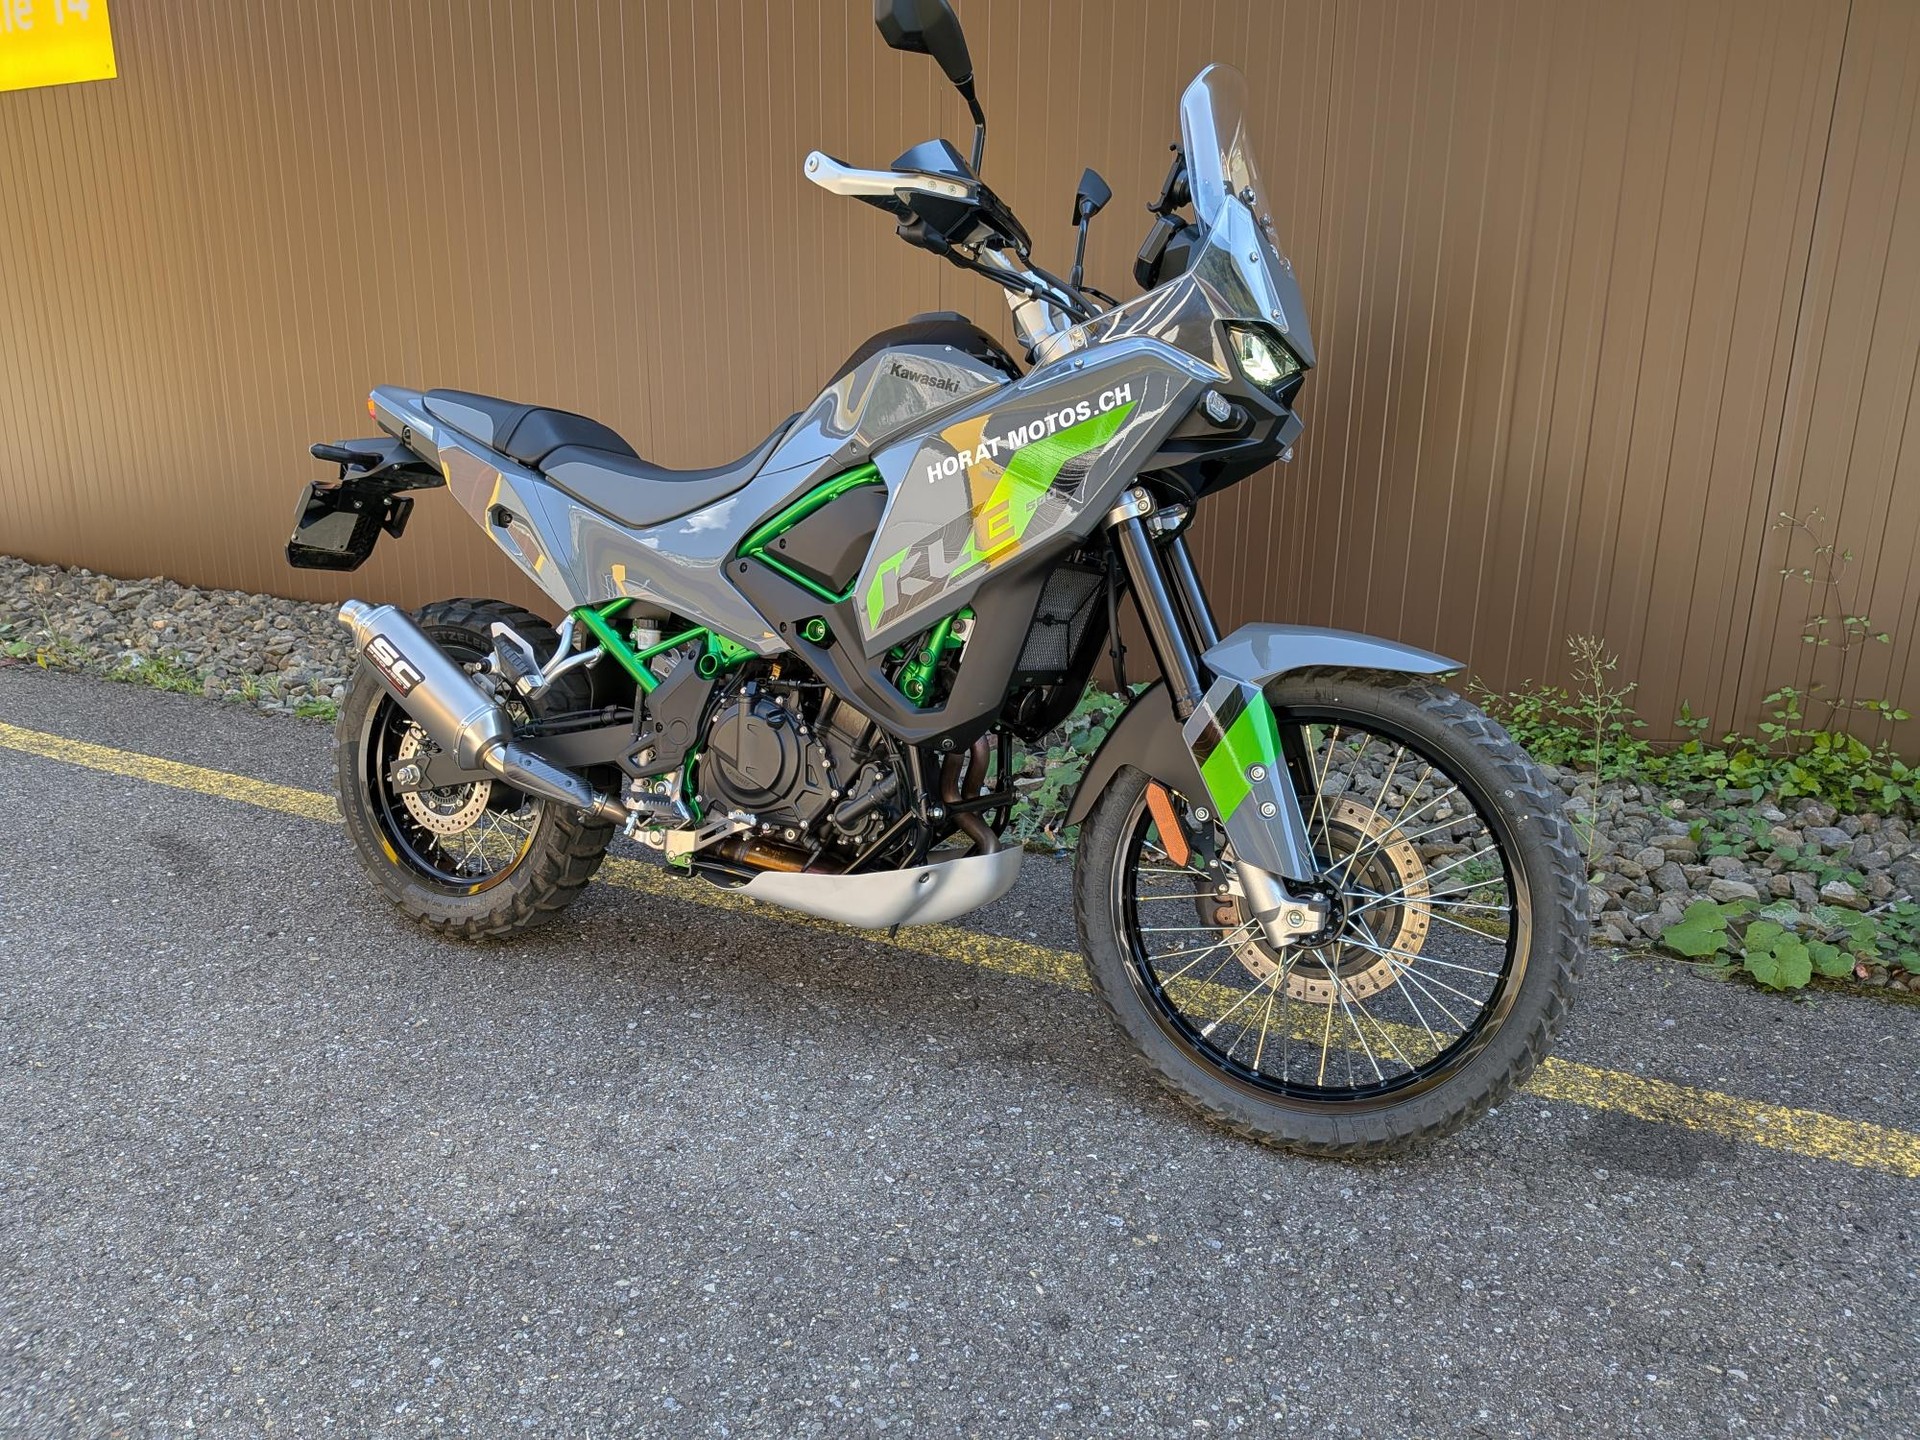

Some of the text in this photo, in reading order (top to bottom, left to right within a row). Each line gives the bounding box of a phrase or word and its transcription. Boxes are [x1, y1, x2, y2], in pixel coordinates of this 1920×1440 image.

[890, 362, 960, 393] Kawasaki
[926, 382, 1132, 484] HORAT MOTOS.CH
[879, 500, 1016, 612] KLE
[368, 637, 422, 688] SC
[428, 630, 490, 652] ETZELER
